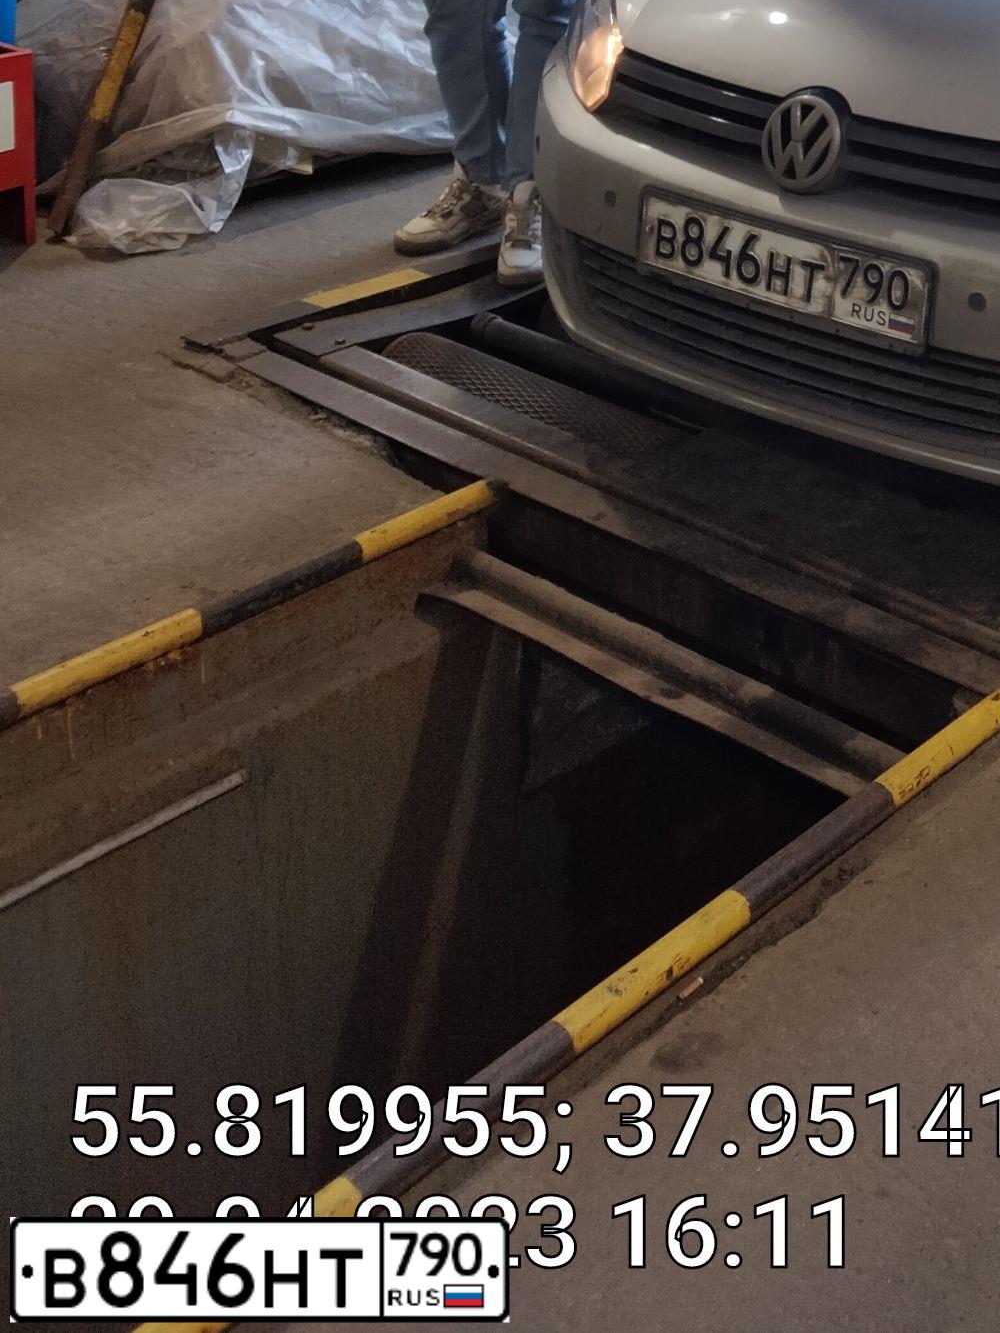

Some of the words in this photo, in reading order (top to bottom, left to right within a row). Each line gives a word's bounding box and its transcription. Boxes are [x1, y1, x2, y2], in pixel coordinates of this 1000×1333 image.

[654, 216, 826, 304] В846НТ
[838, 253, 910, 312] 790
[851, 302, 887, 327] RUS
